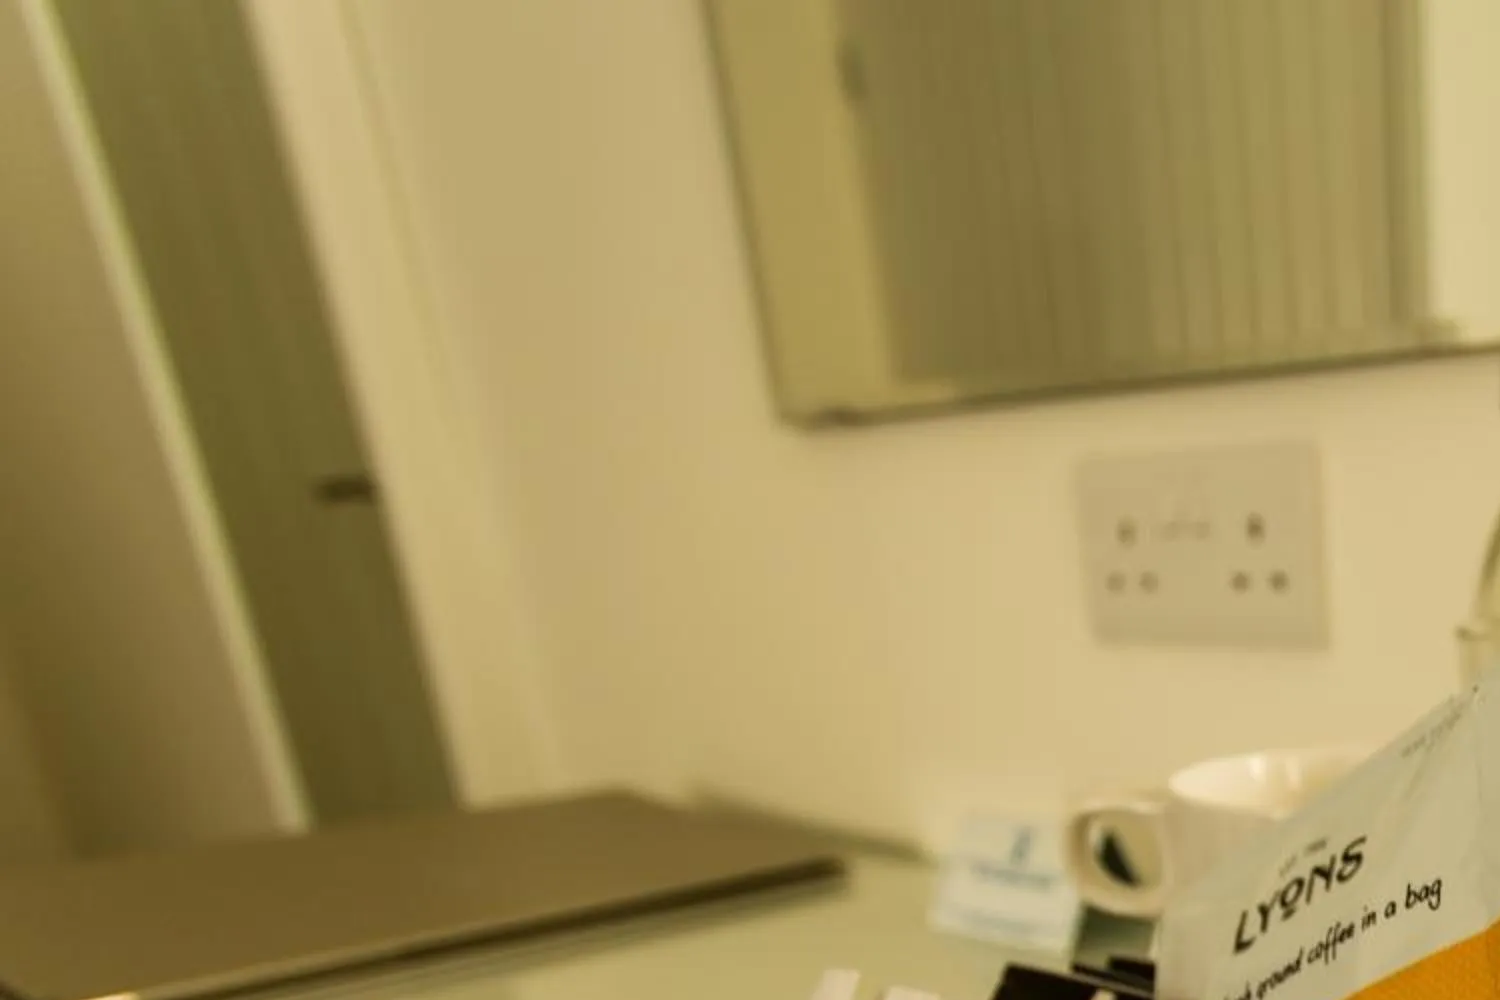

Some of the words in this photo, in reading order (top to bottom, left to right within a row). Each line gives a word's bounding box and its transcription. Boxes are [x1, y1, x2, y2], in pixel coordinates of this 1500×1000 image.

[1233, 834, 1367, 955] LYONS
[1306, 921, 1356, 966] coffee
[1361, 904, 1377, 932] in
[1383, 900, 1397, 919] a
[1404, 878, 1442, 911] bag
